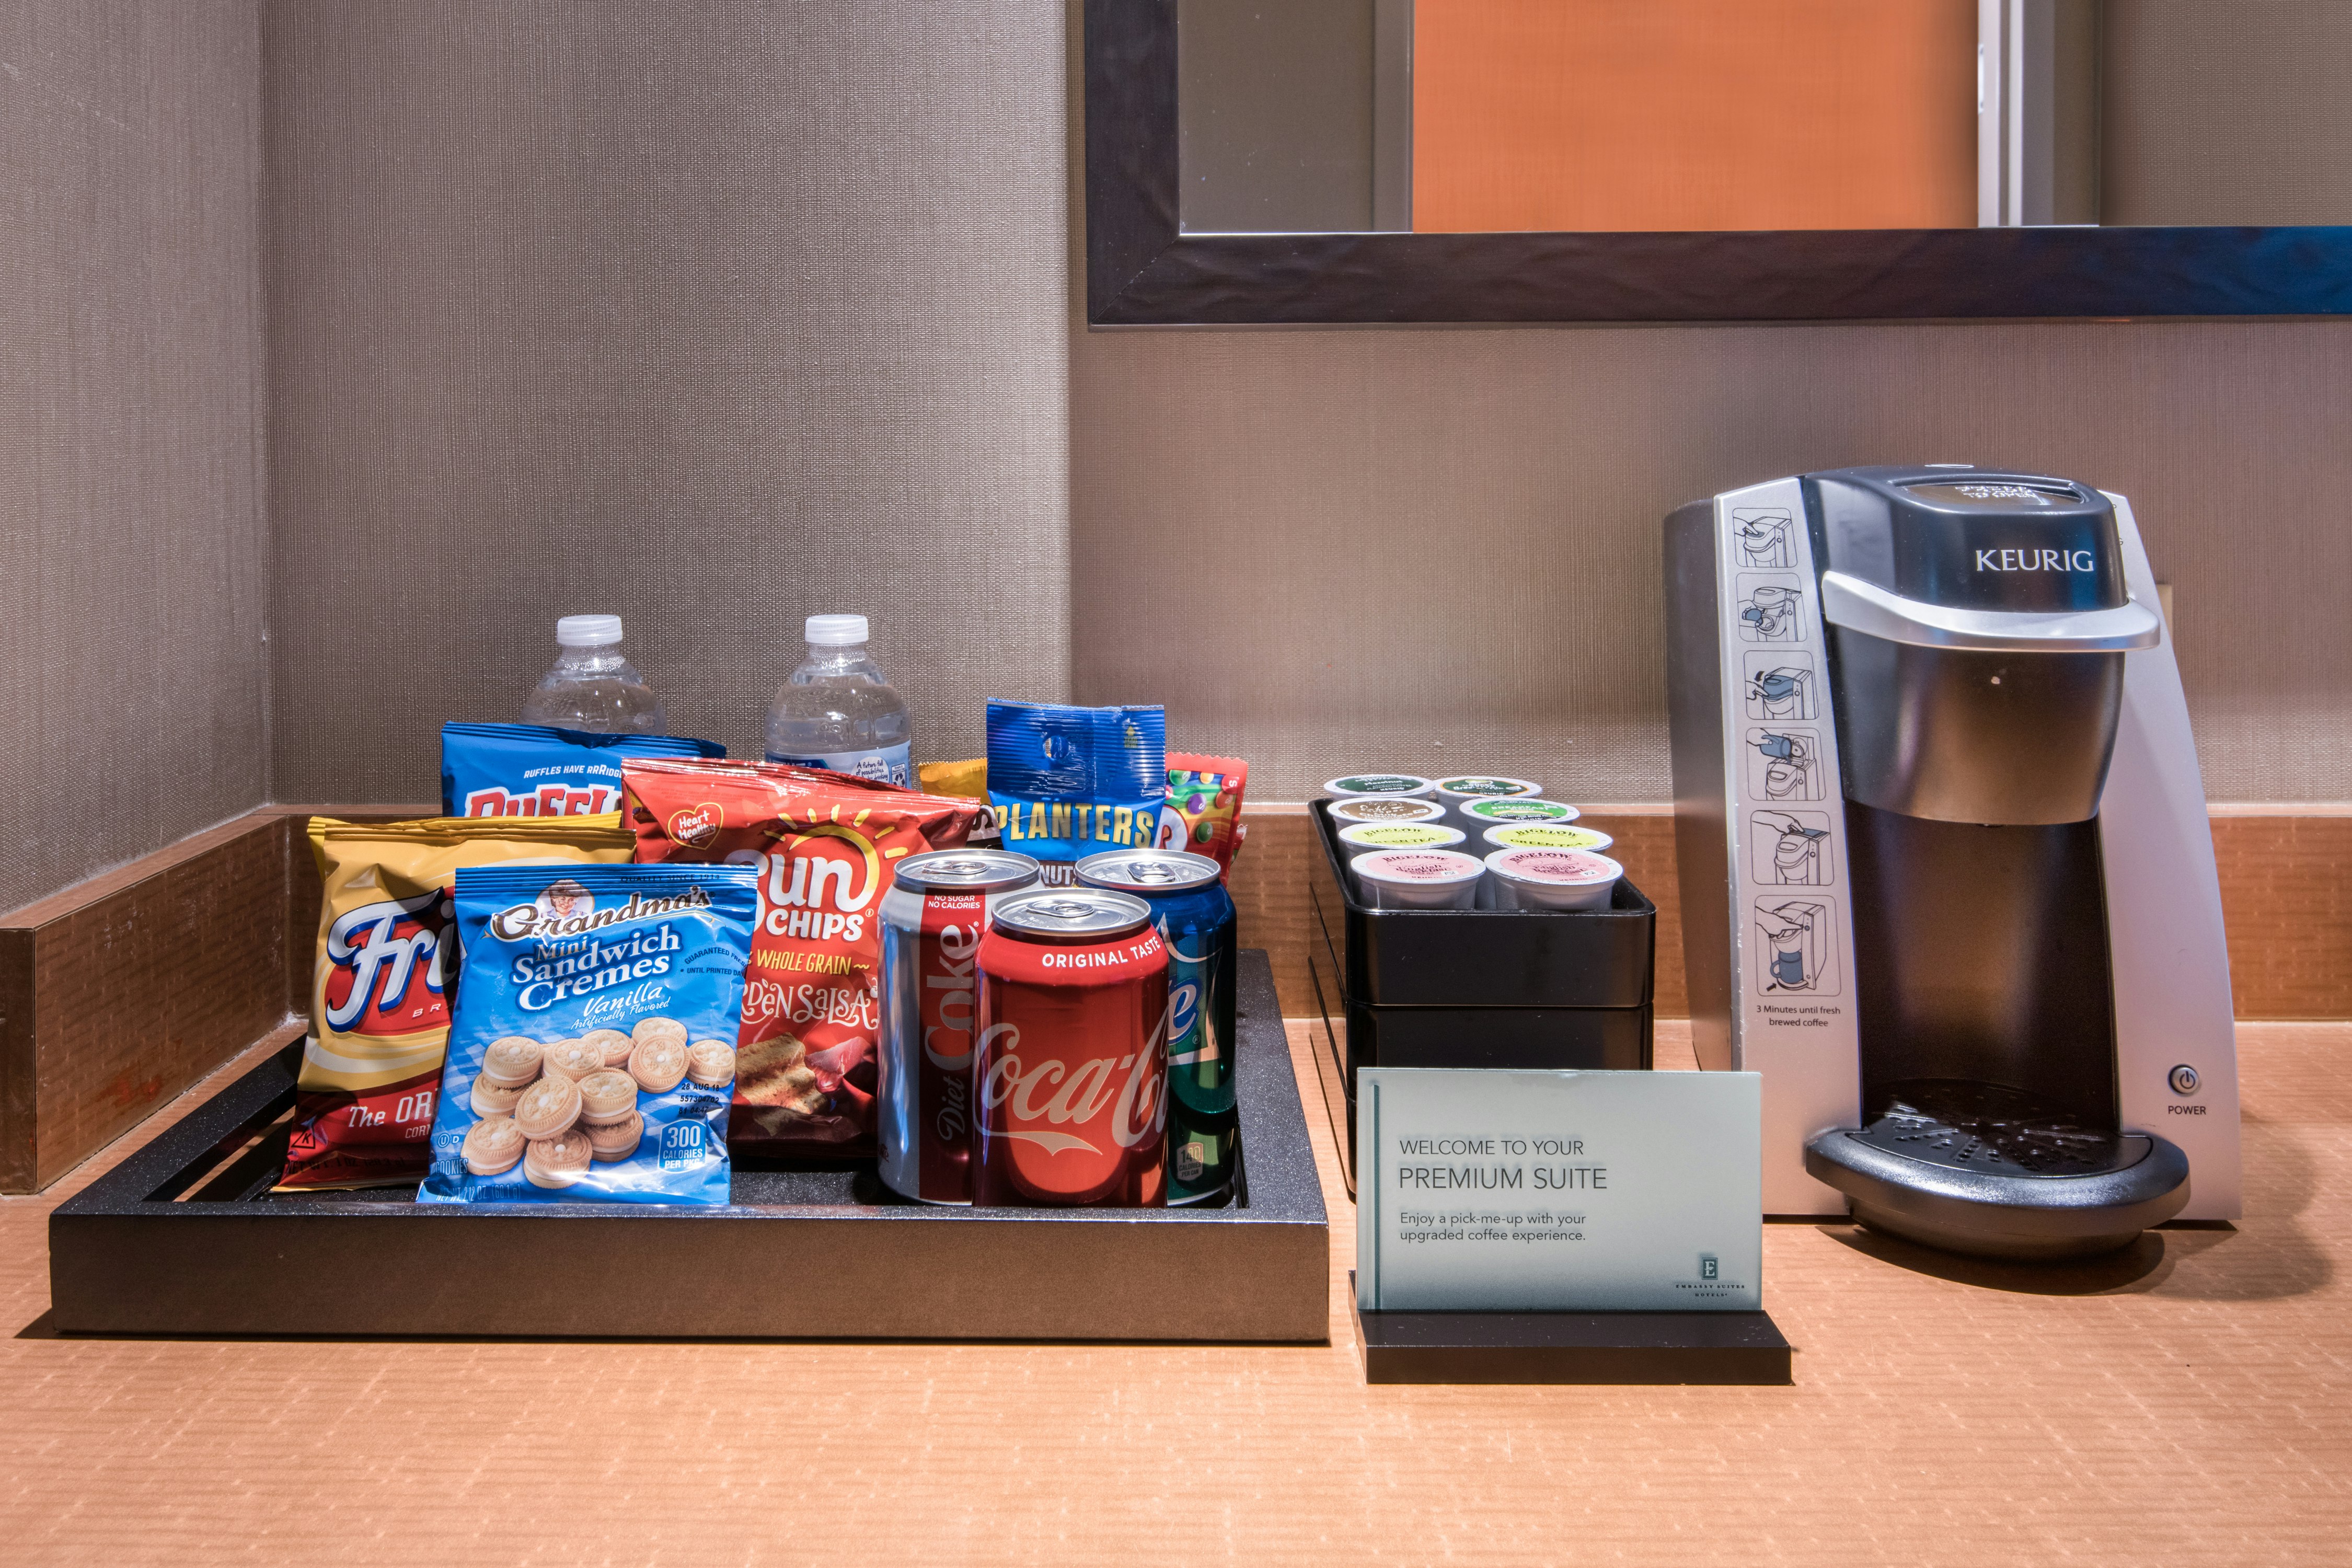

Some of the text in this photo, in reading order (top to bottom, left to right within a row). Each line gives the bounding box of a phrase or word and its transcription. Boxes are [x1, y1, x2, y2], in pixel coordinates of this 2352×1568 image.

[1976, 549, 2094, 571] KEURIG
[524, 766, 561, 778] RUFFLES
[563, 765, 585, 774] HAVE
[861, 767, 884, 777] possibilities
[679, 810, 710, 829] Heart
[994, 803, 1155, 849] PLANTERS
[678, 823, 716, 840] Healthy
[1364, 828, 1424, 836] BIGELOW
[1516, 829, 1577, 838] BIGELOW
[1509, 852, 1572, 862] BIGELOW
[1039, 865, 1076, 884] NUT
[492, 885, 712, 939] Grandma's
[766, 908, 864, 942] CHIPS
[513, 925, 679, 983] Sandwich
[536, 936, 587, 961] Mini
[685, 947, 730, 964] GUARANTEED
[1042, 937, 1161, 967] ORIGINAL TASTE
[757, 949, 802, 972] WHOLE
[805, 952, 852, 976] GRAIN
[520, 954, 669, 1010] Cremes
[583, 982, 663, 1017] Vanilla
[925, 924, 977, 1071] Coke
[570, 996, 671, 1030] Artificially Flavored
[1764, 1005, 1797, 1013] Minutes
[1769, 1018, 1828, 1027] brewed coffee
[349, 1106, 386, 1127] The
[937, 1075, 965, 1141] Diet
[2168, 1105, 2206, 1115] POWER
[667, 1125, 700, 1148] 300
[663, 1148, 703, 1159] CALORIES
[1181, 1146, 1201, 1163] 140
[1400, 1140, 1584, 1156] WELCOME TO YOUR
[435, 1158, 469, 1175] COOKIES
[665, 1160, 681, 1169] PER
[1179, 1162, 1201, 1171] CALORIES
[1399, 1167, 1608, 1190] PREMIUM SUITE
[464, 1186, 475, 1202] 2.12
[1400, 1213, 1435, 1226] Enjoy
[1450, 1212, 1523, 1226] pick-me-up
[1527, 1212, 1553, 1224] with
[1557, 1216, 1586, 1226] your
[1400, 1228, 1586, 1243] upgraded coffee experience.
